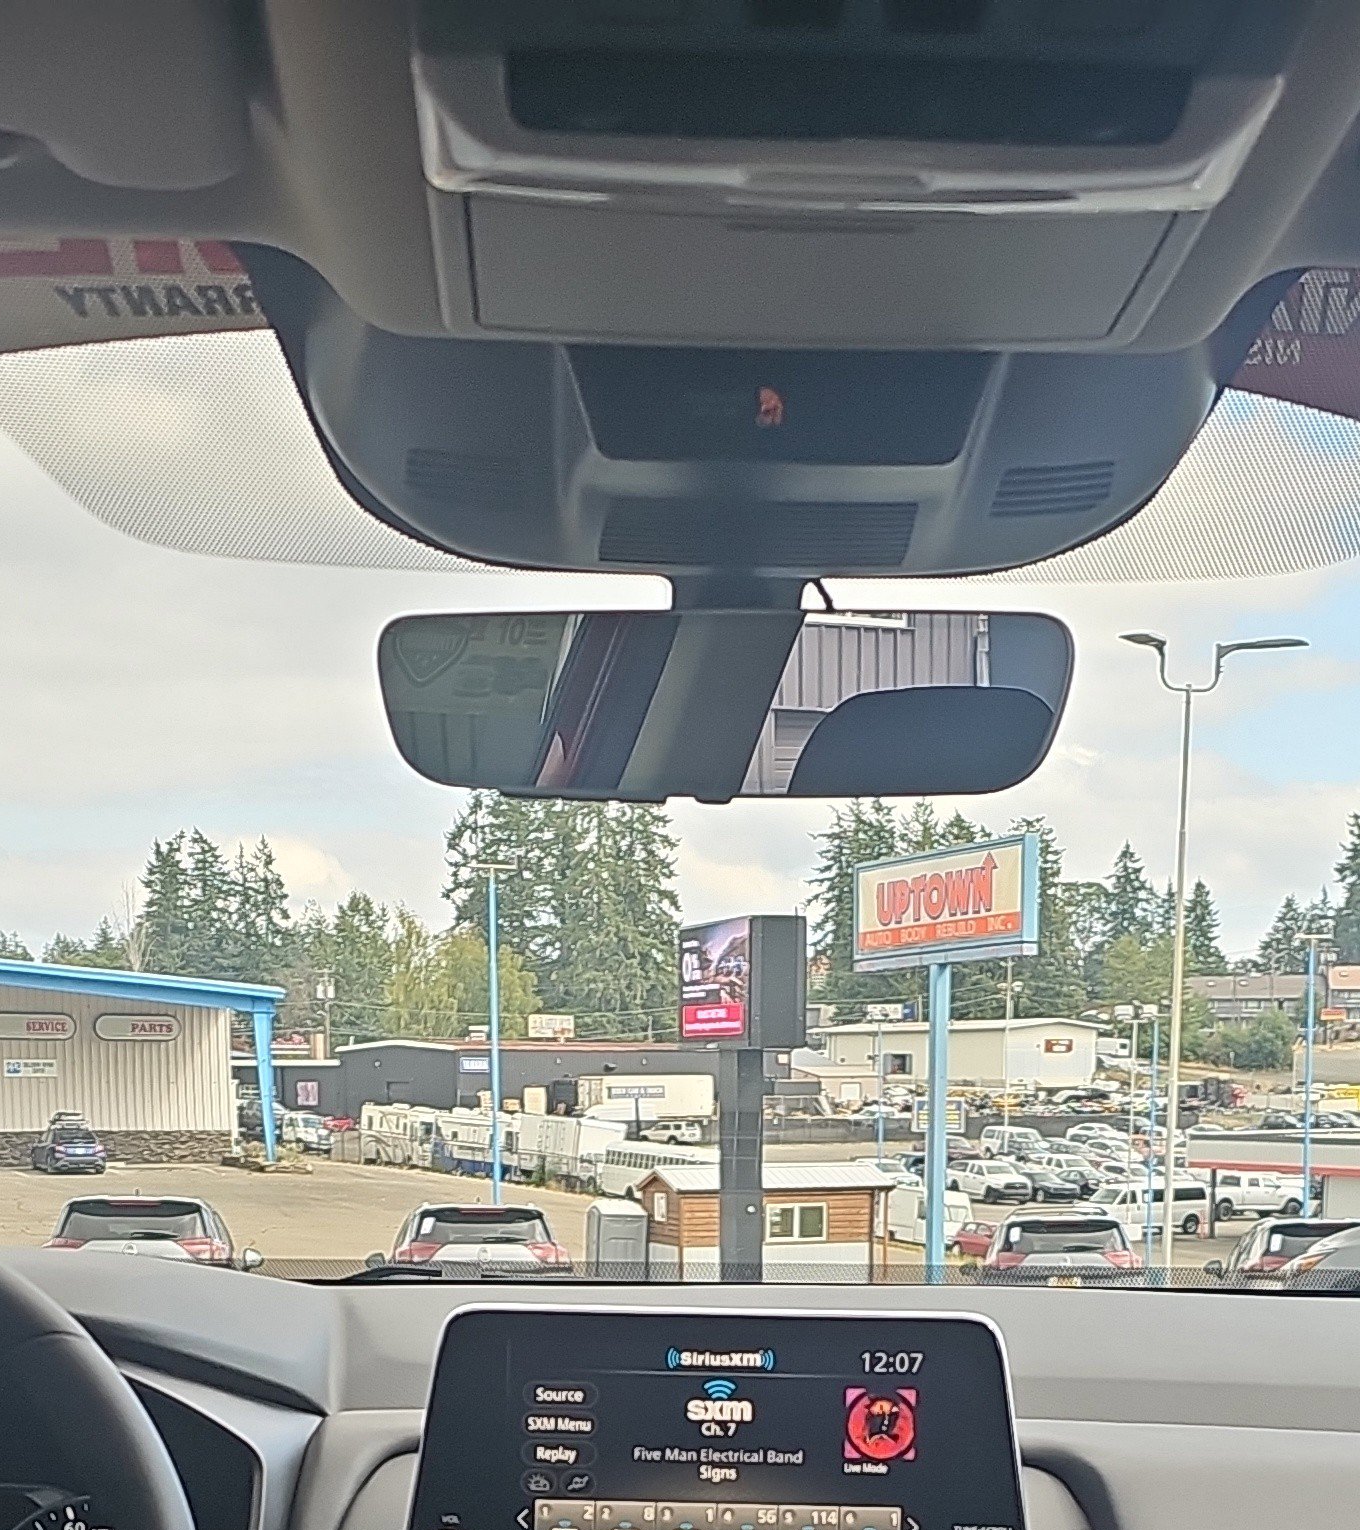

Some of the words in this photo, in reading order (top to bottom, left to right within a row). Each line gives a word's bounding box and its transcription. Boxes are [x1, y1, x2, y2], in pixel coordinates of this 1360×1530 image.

[876, 852, 998, 926] UPTOWN
[864, 931, 891, 947] AUTO
[900, 926, 927, 942] BODY
[935, 920, 976, 939] REBUILD
[26, 1020, 68, 1032] SERVICE
[130, 1022, 173, 1034] PARTS
[861, 1352, 924, 1373] 12:07
[535, 1387, 585, 1403] Source
[527, 1416, 555, 1431] SXM
[557, 1417, 592, 1432] Menu
[726, 1422, 737, 1437] 7
[536, 1446, 577, 1464] Replay
[633, 1447, 661, 1461] Five
[664, 1448, 698, 1462] Man
[700, 1449, 763, 1463] Electrical
[766, 1450, 804, 1464] Band
[699, 1464, 738, 1482] Signs
[843, 1463, 862, 1474] Live
[862, 1464, 888, 1475] Mode
[583, 1505, 594, 1520] 2
[705, 1508, 714, 1522] 1
[757, 1510, 777, 1525] 56
[811, 1511, 838, 1525] 114
[890, 1512, 899, 1527] 1
